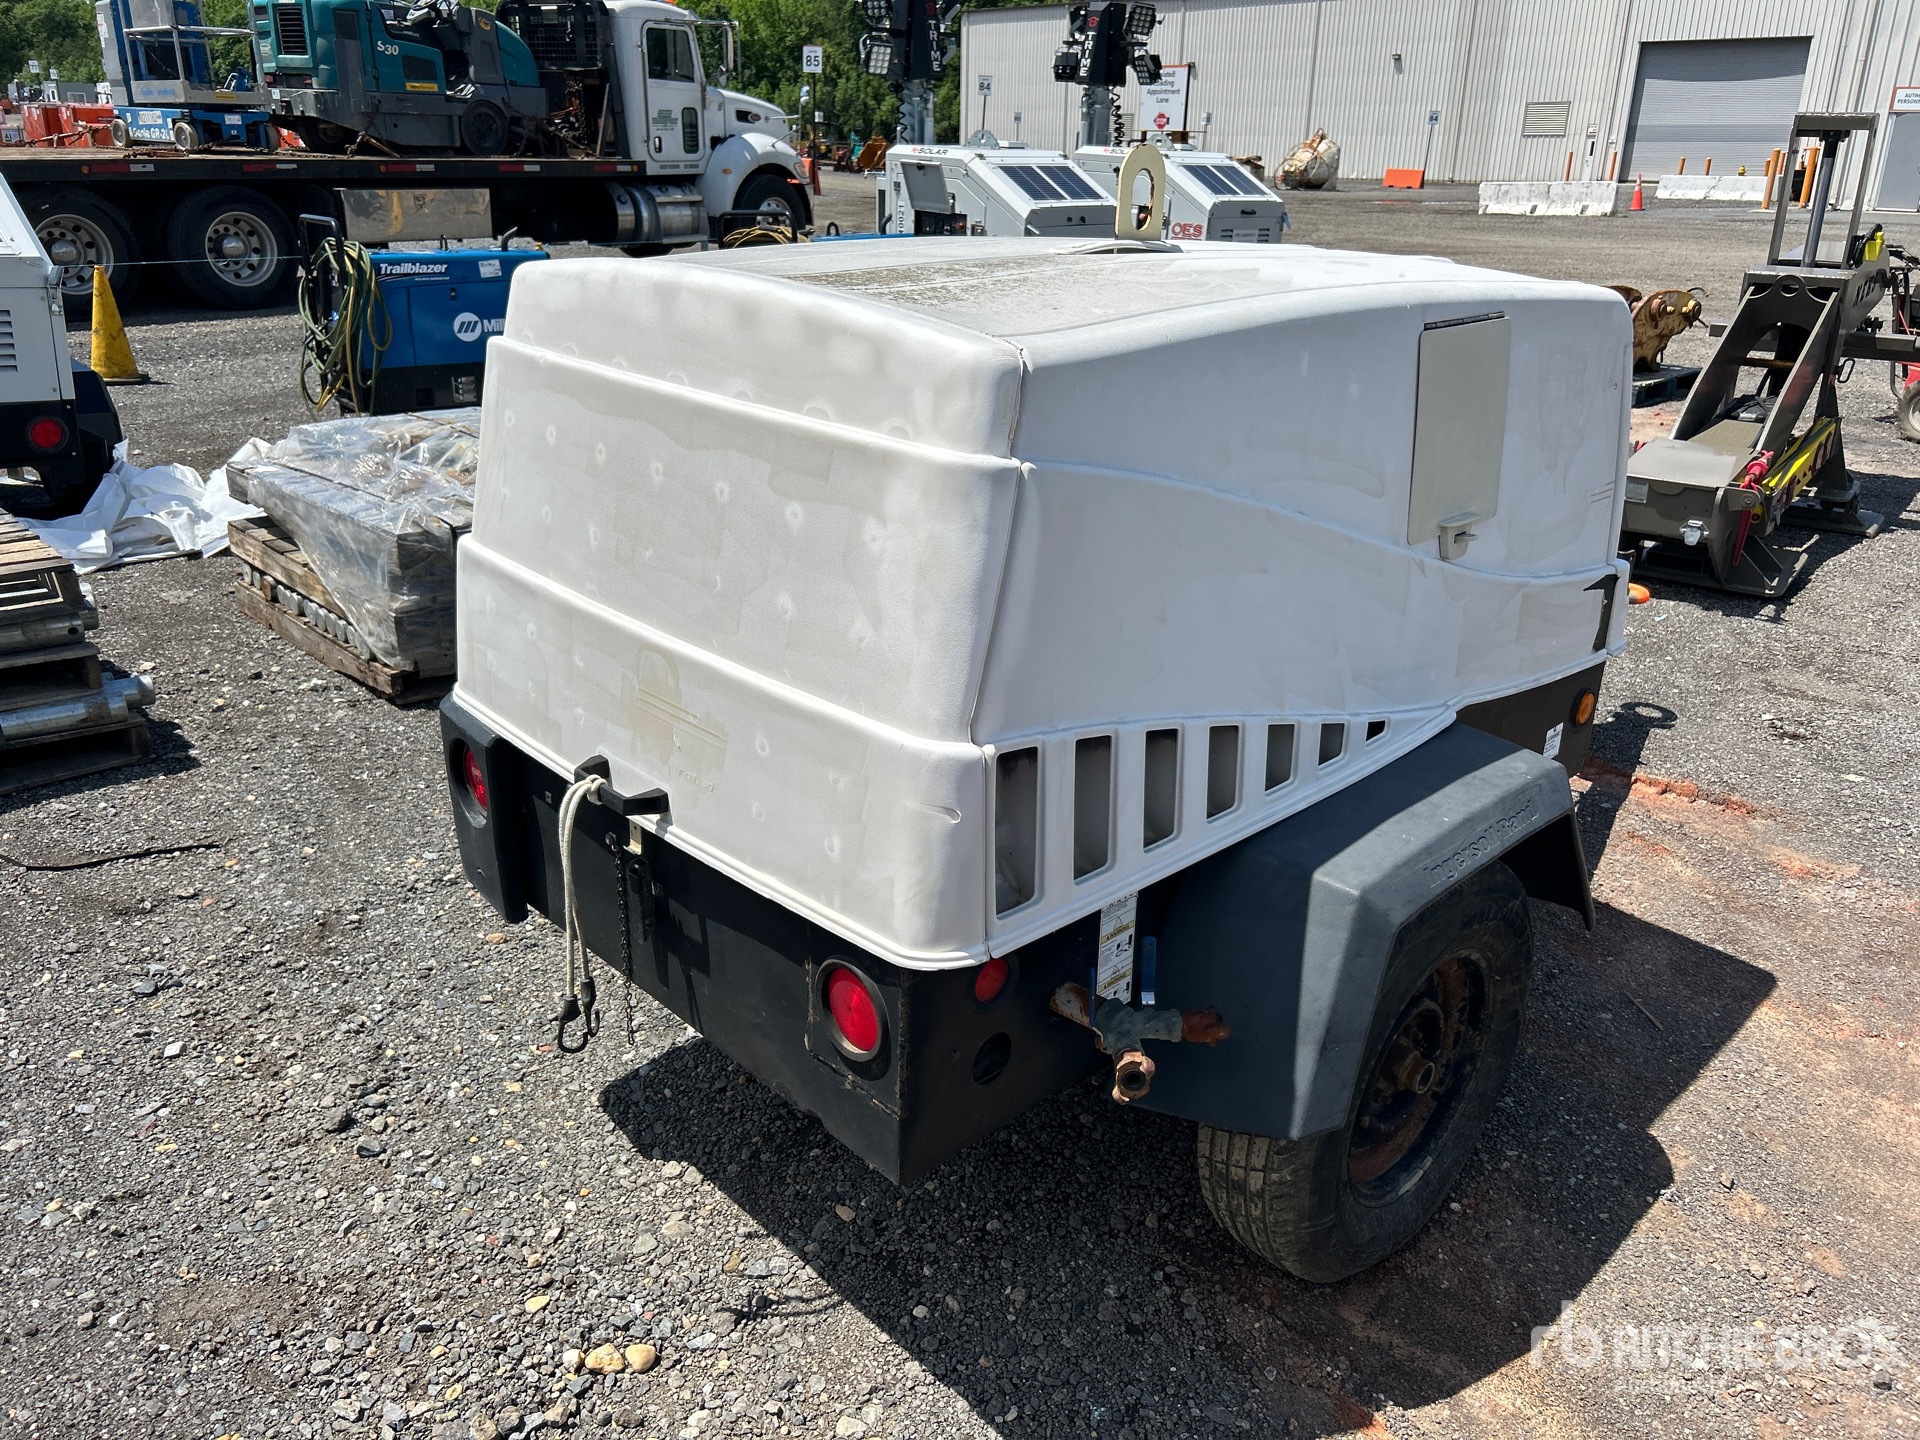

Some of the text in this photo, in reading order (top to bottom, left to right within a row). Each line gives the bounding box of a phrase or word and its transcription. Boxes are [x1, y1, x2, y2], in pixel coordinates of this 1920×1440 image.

[377, 40, 399, 55] S30
[928, 20, 941, 71] TRIME
[1080, 31, 1097, 76] TRIME
[805, 55, 820, 67] 85
[978, 82, 991, 91] 84
[1146, 88, 1181, 96] Appointment
[1171, 222, 1203, 238] OES
[380, 262, 448, 275] Trailblazer
